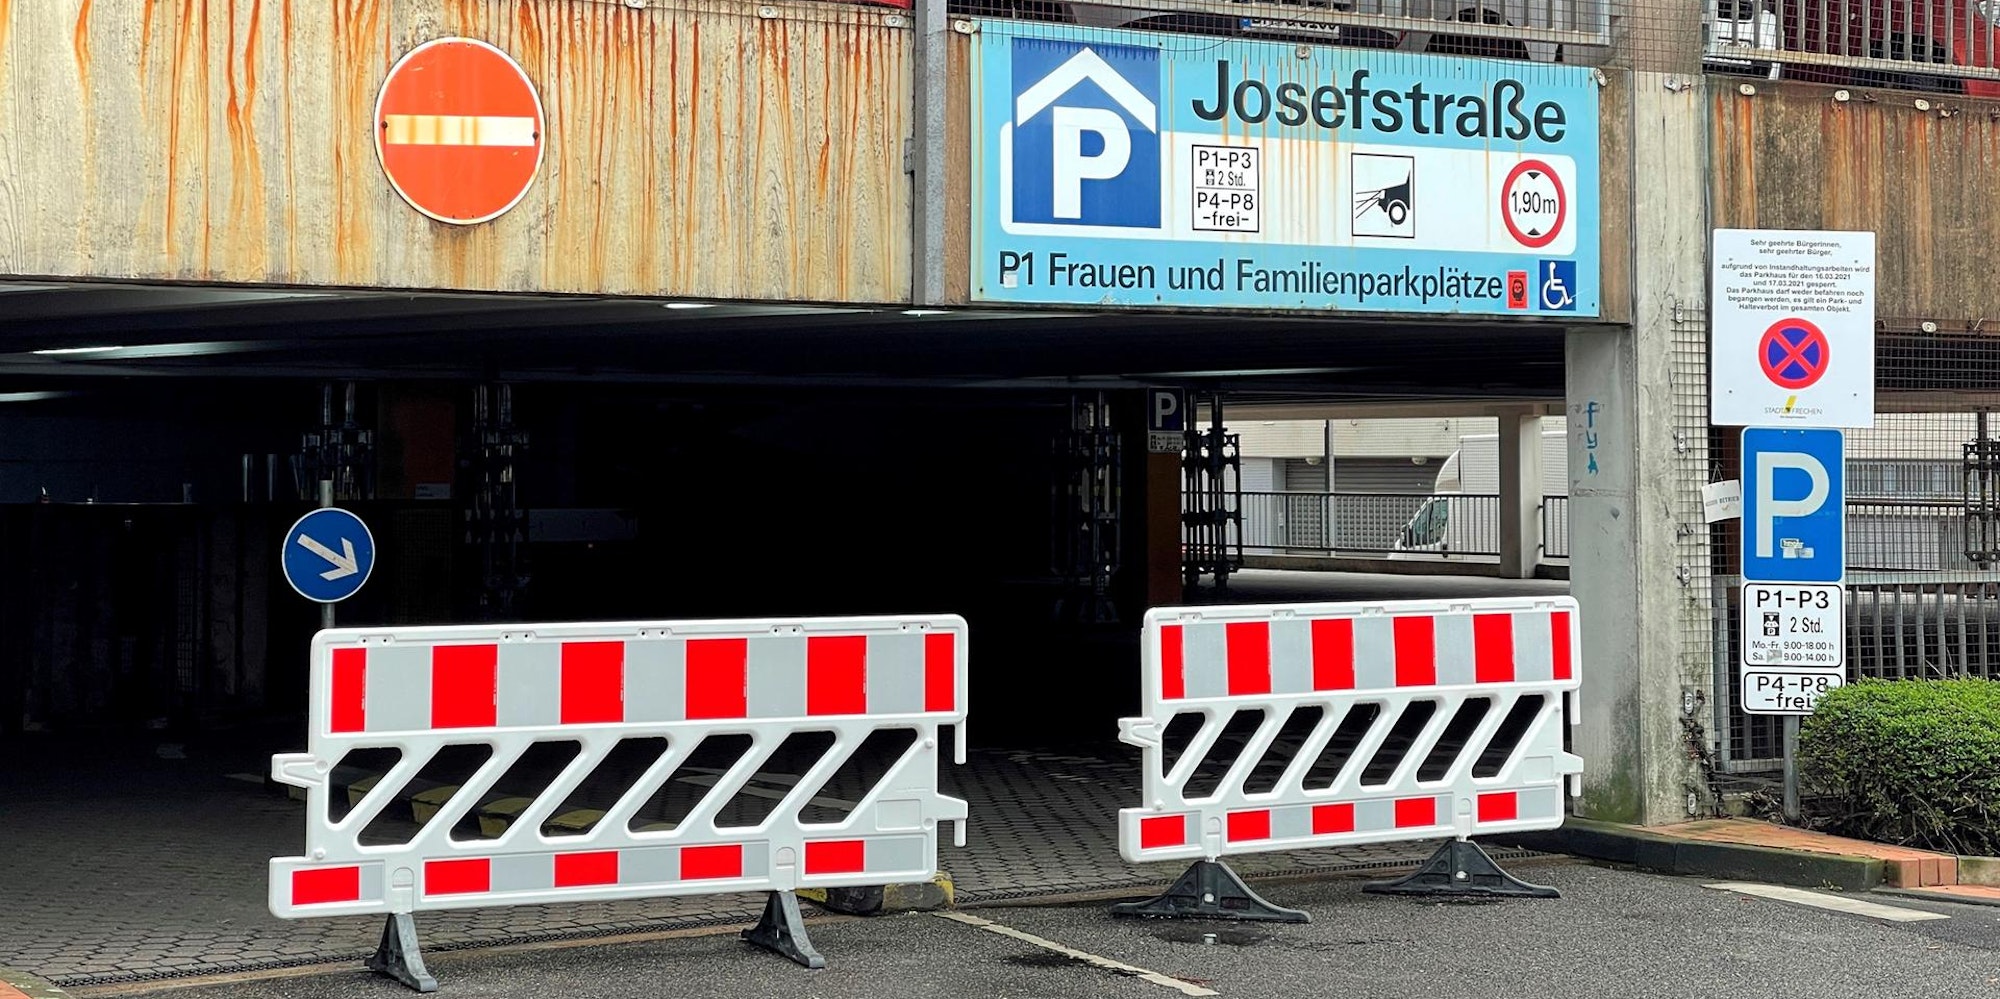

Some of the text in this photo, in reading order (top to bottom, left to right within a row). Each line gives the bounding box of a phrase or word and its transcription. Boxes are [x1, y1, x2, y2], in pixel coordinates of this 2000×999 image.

[1191, 60, 1566, 143] Josefstraße
[1053, 106, 1131, 219] P
[1199, 150, 1252, 169] P1-P3
[1218, 170, 1246, 187] 2 Std.
[1197, 191, 1254, 211] P4-P8
[1754, 271, 1787, 279] Parkhaus
[1769, 264, 1853, 272] Instandhaltungsarbeiten
[999, 250, 1503, 306] P1 Frauen und Familienparkplätze
[1728, 295, 1763, 303] begangen
[1156, 392, 1177, 428] P
[1756, 451, 1830, 558] P
[1757, 589, 1829, 609] P1-P3
[1790, 616, 1824, 633] 2 Std.
[1829, 642, 1834, 650] h
[1829, 654, 1834, 662] h
[1757, 676, 1828, 693] P4-P8
